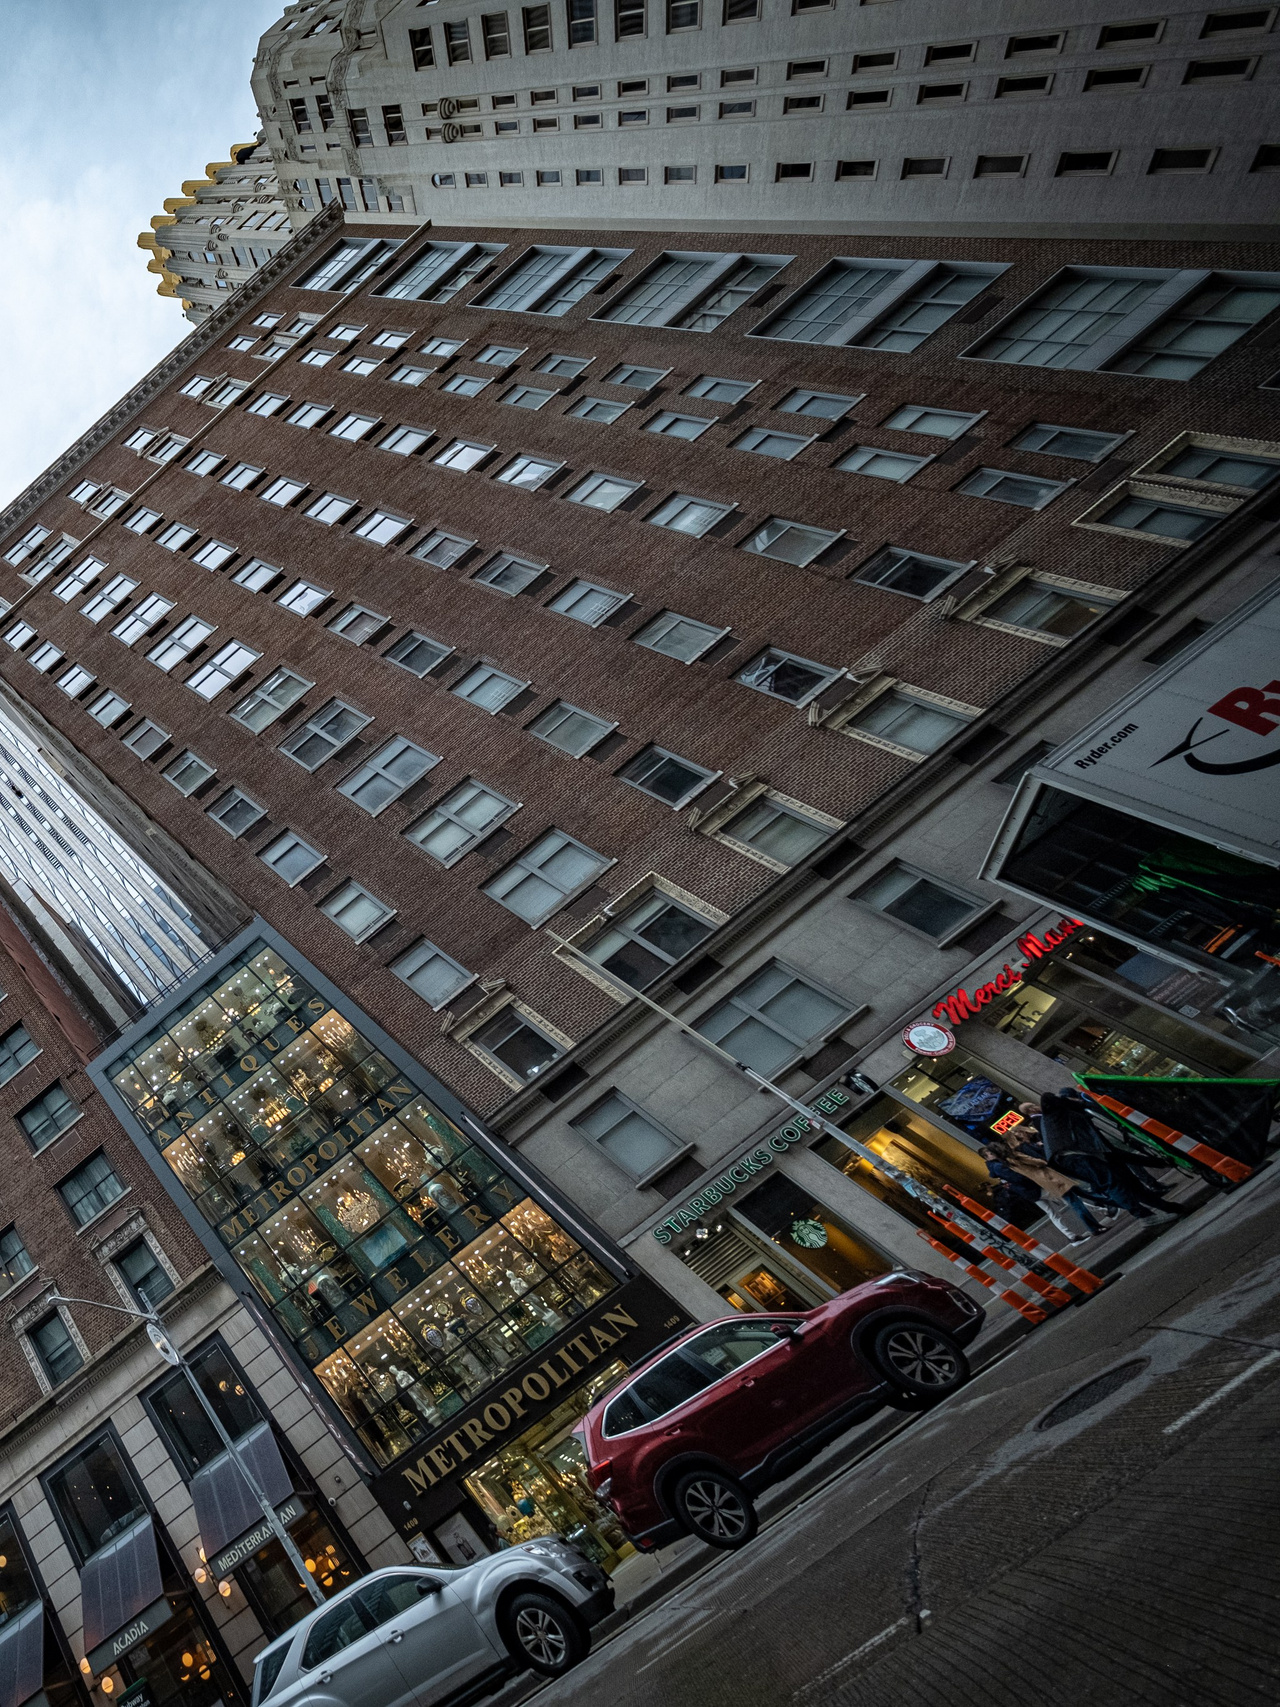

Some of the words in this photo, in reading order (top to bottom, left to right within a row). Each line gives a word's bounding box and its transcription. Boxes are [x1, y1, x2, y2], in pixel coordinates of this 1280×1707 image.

[1074, 721, 1139, 770] Ryder.com
[932, 964, 1023, 1026] Merci
[154, 997, 328, 1147] ANTIQUES
[993, 1112, 1021, 1134] OPEN
[220, 1080, 415, 1244] METROPOLITAN
[653, 1148, 773, 1245] STARBUCKS
[303, 1180, 519, 1360] JEWELERY
[663, 1315, 680, 1329] 1409
[401, 1303, 639, 1495] METROPOLITAN
[218, 1504, 297, 1572] MEDiTERRANAN
[403, 1517, 419, 1531] 1409
[113, 1620, 150, 1656] ACADiA
